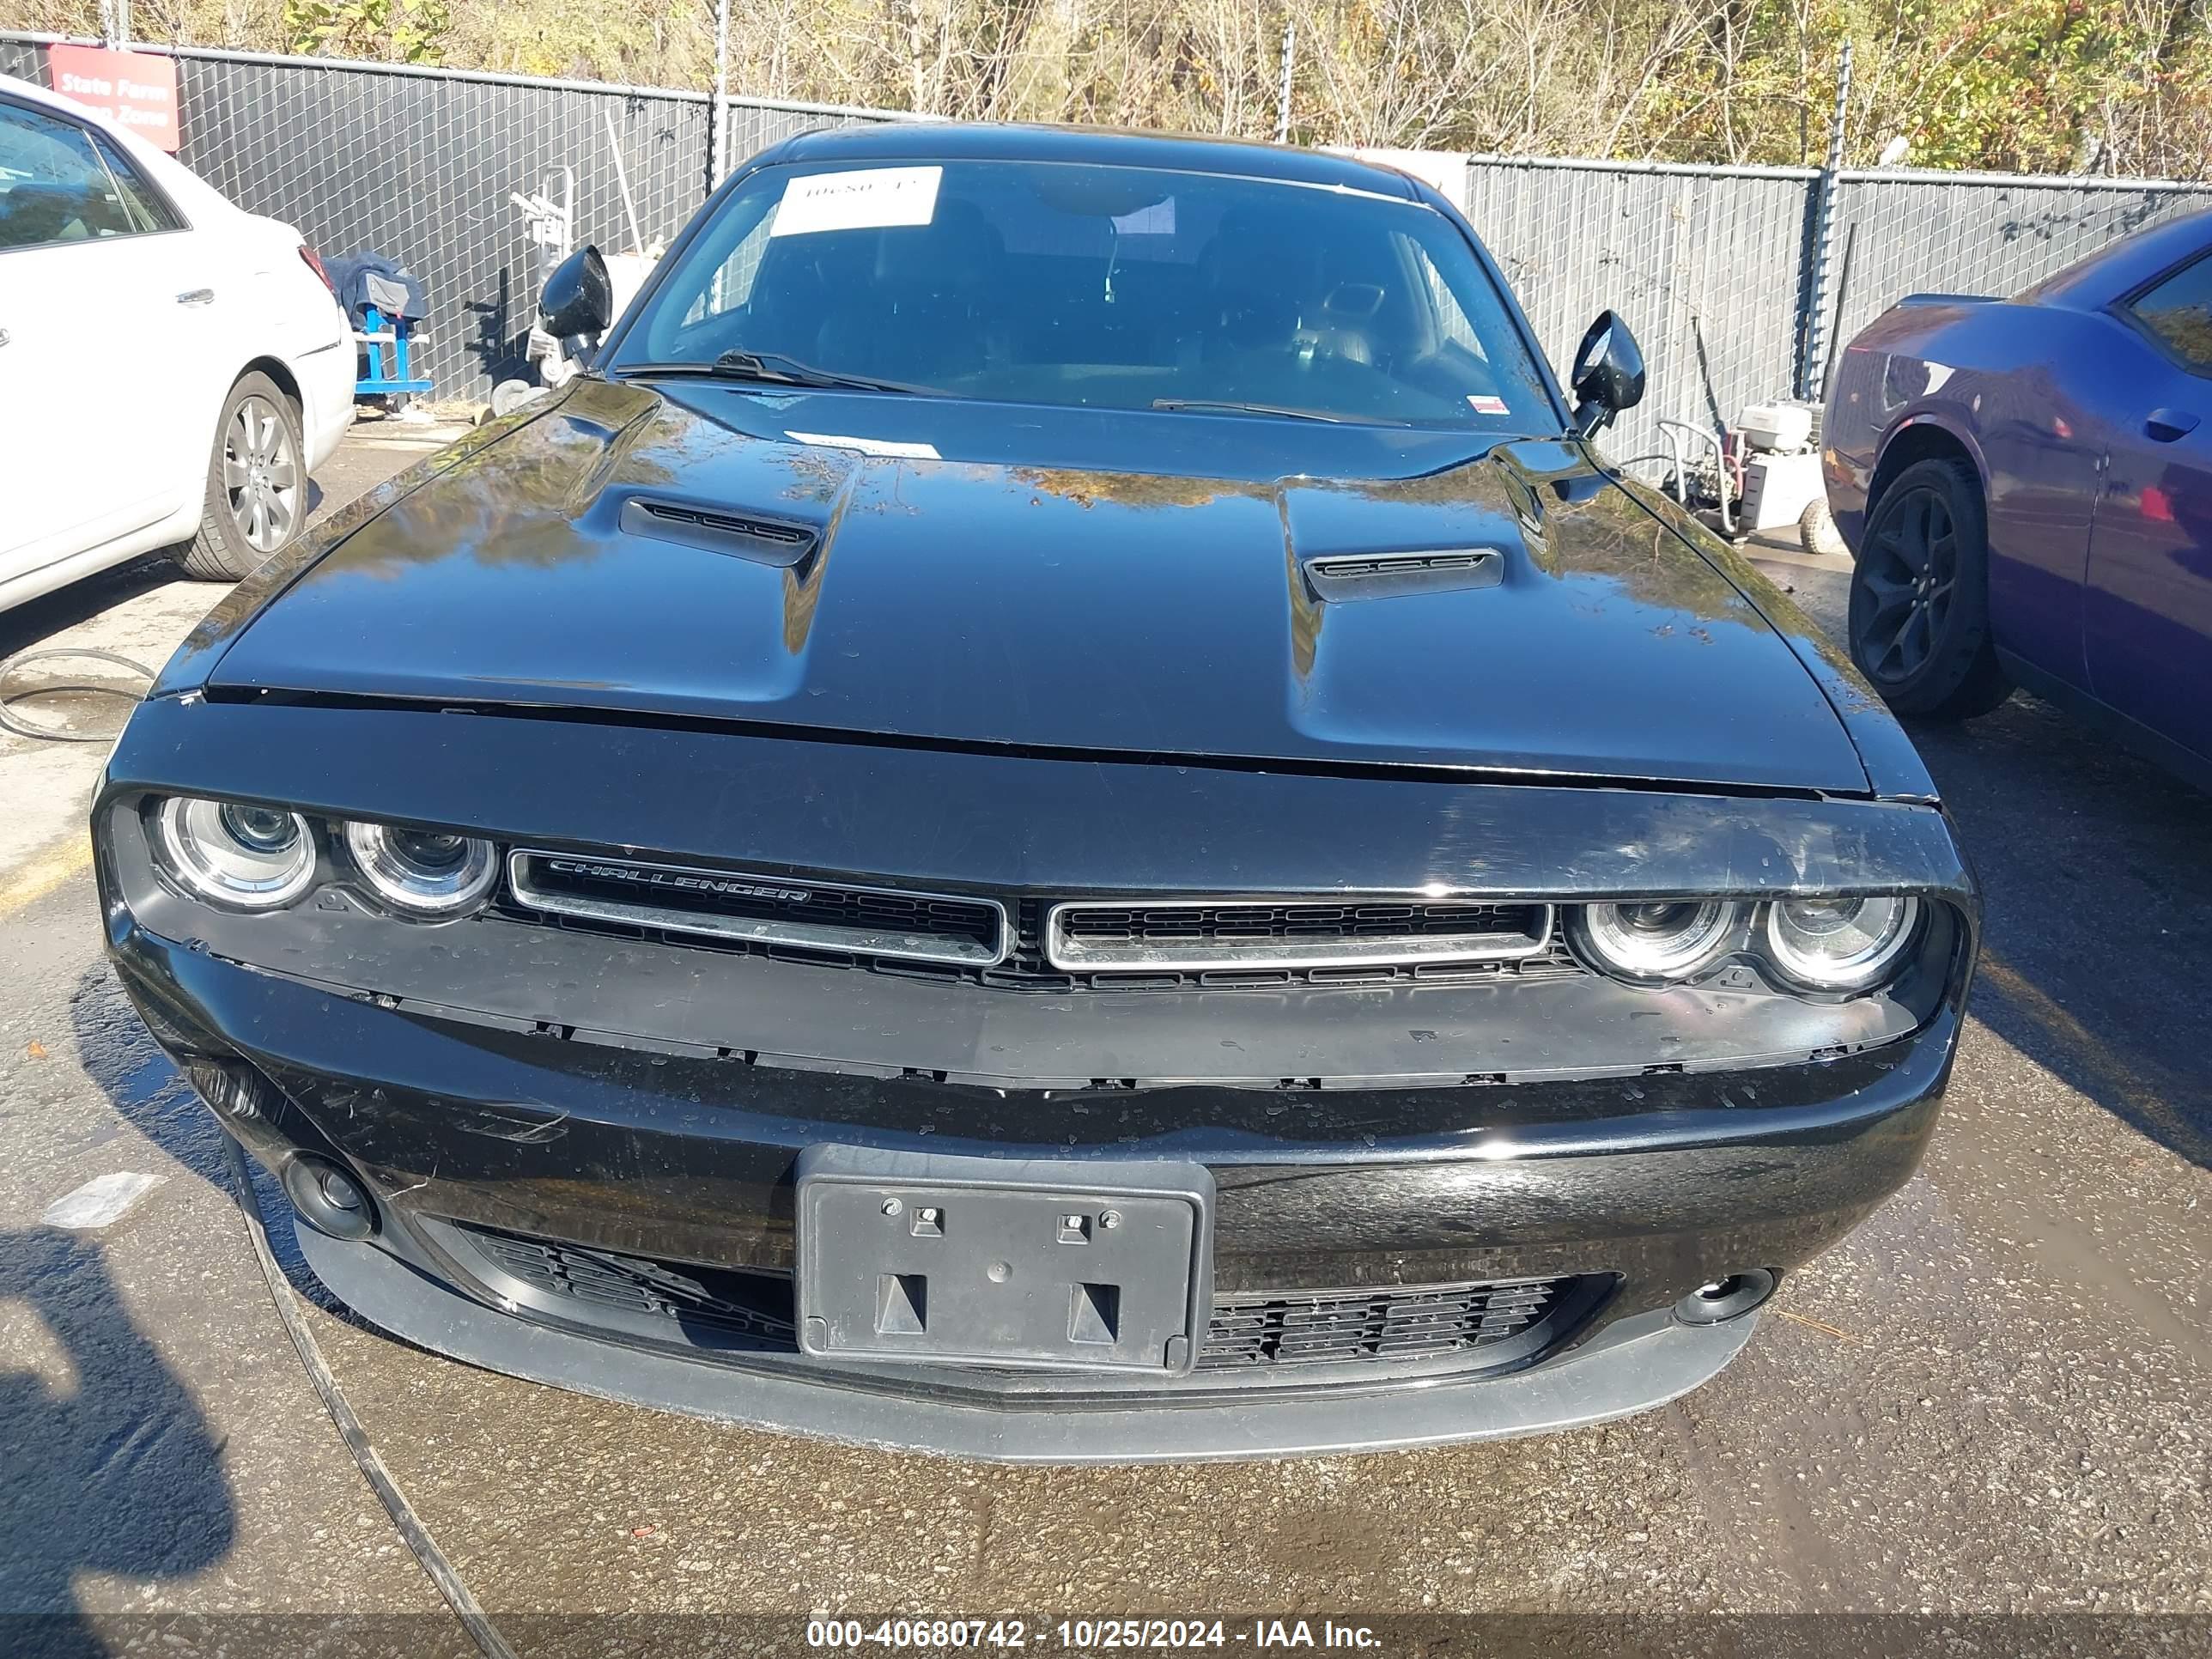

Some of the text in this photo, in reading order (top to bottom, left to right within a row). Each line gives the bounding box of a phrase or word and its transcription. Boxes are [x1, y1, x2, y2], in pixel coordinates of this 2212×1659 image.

[62, 72, 167, 101] State Farm
[117, 104, 168, 127] Zone
[550, 860, 809, 902] CHALLENGER
